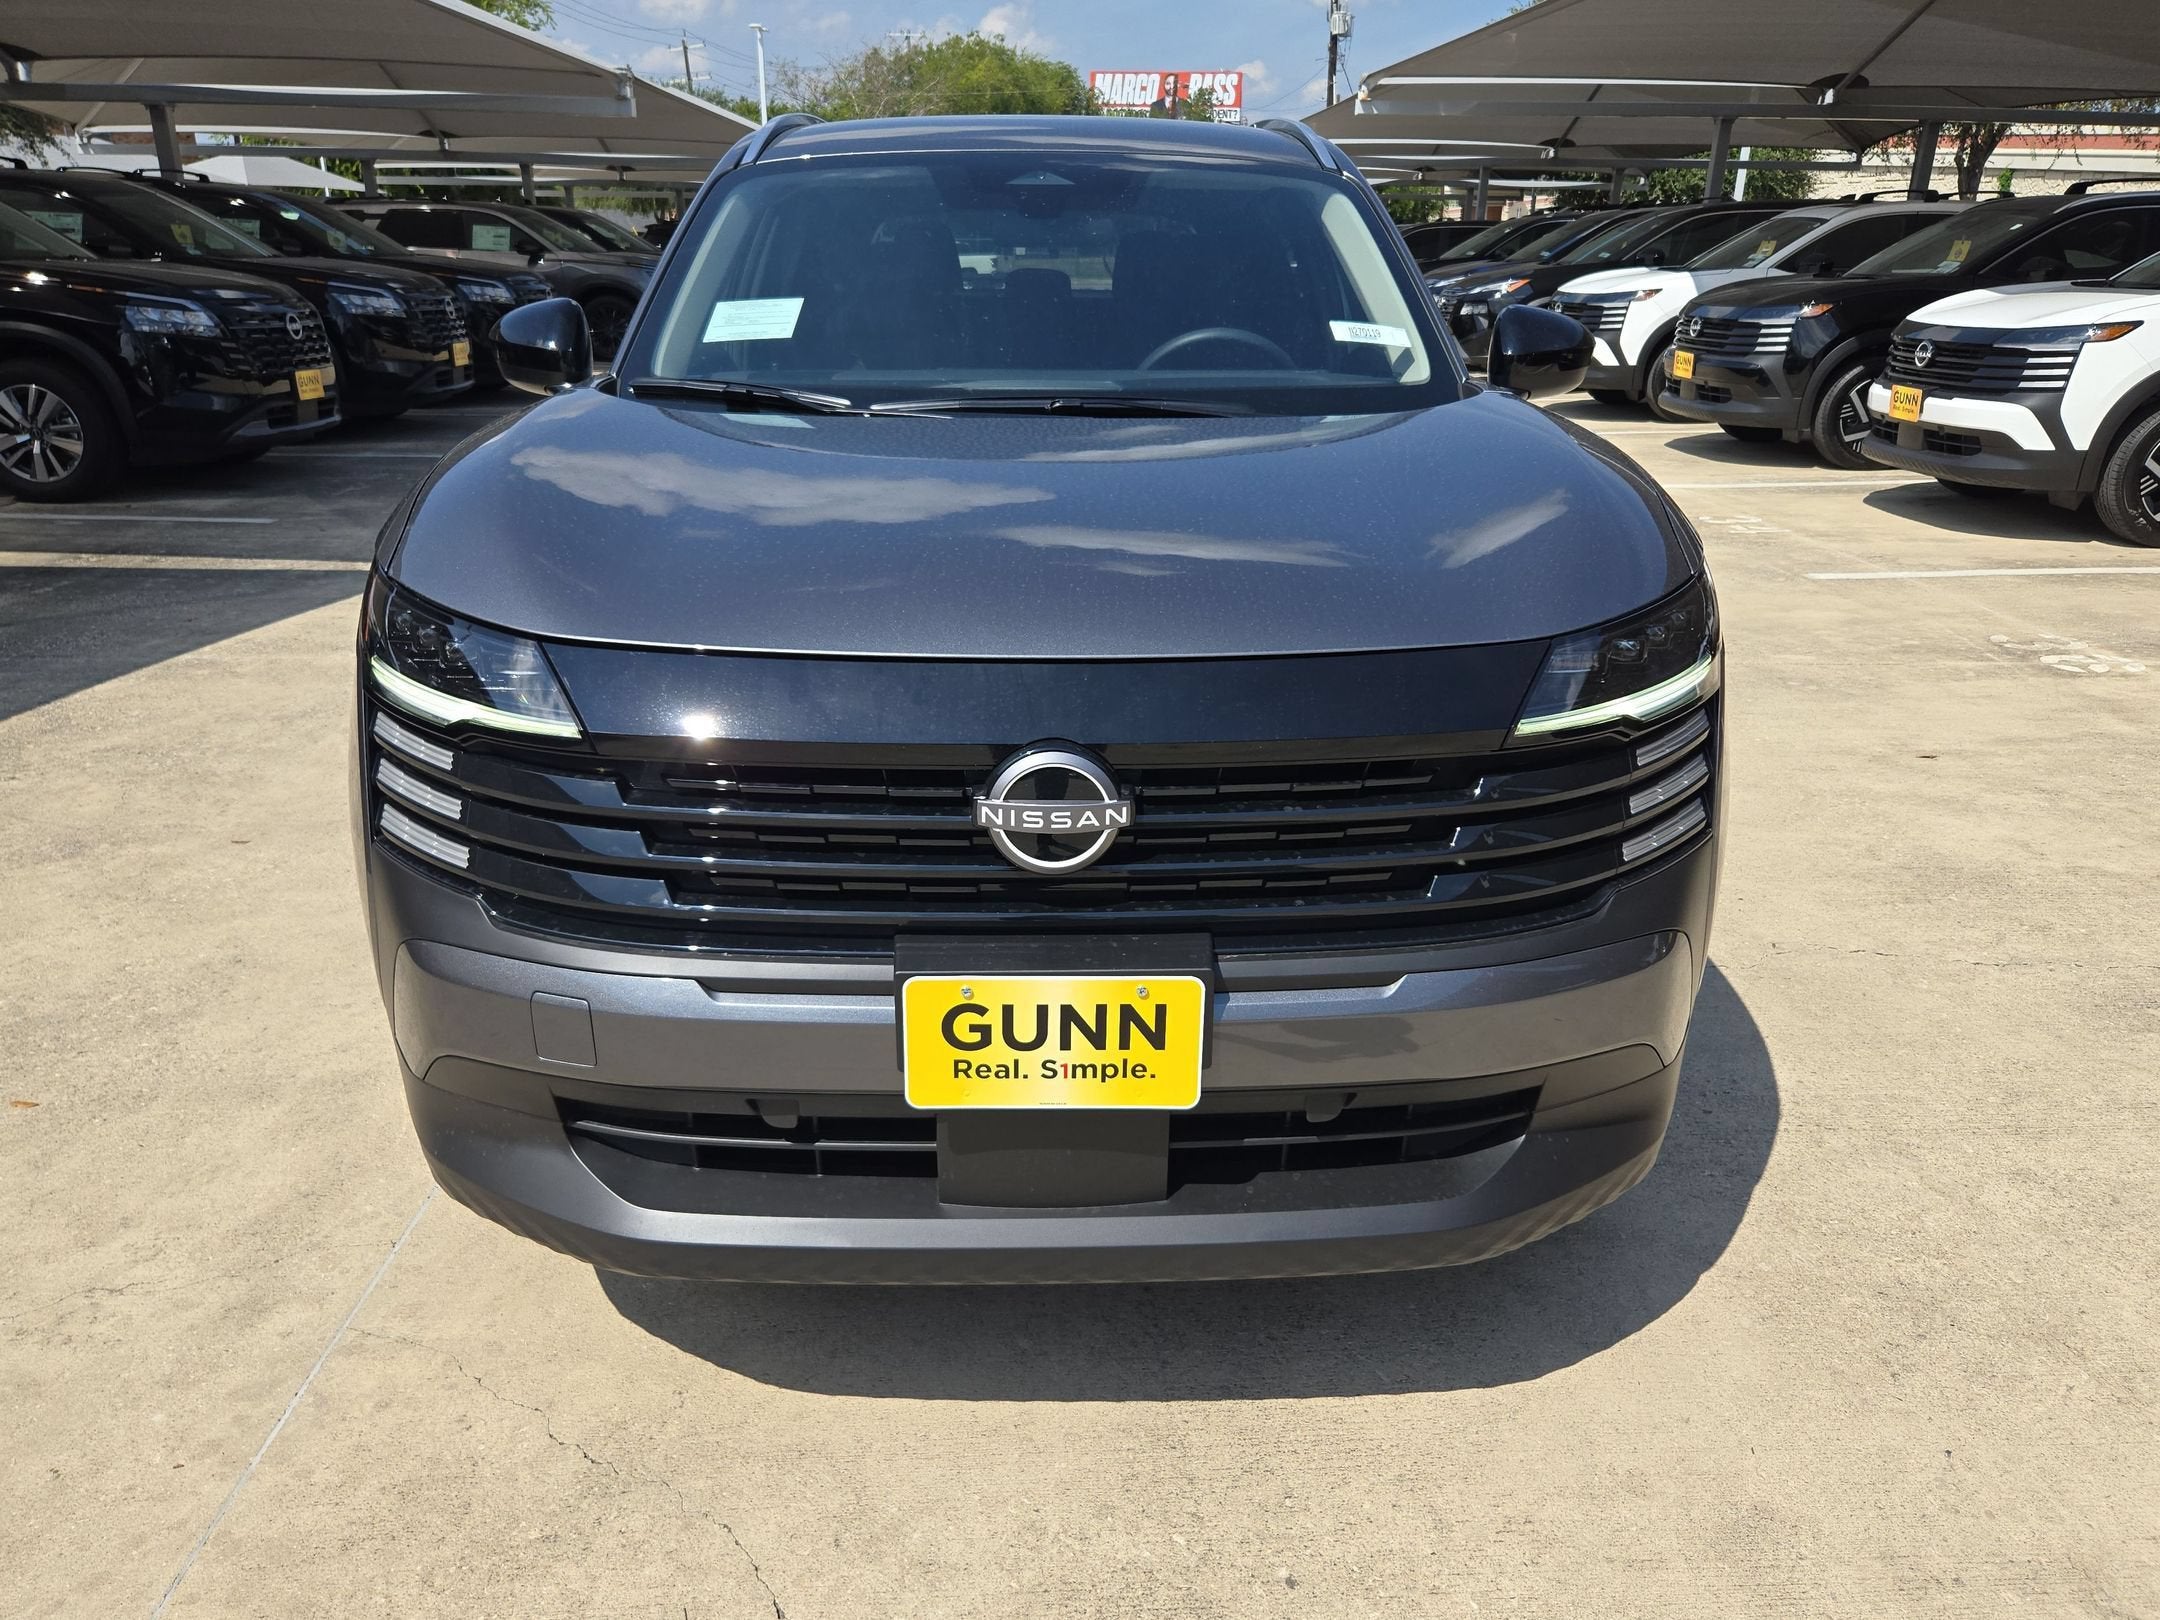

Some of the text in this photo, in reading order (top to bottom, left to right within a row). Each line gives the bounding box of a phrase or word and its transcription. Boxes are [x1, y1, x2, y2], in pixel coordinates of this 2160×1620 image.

[1095, 73, 1160, 105] MARCO
[1893, 390, 1919, 406] GUNN
[981, 806, 1127, 829] NISSAN
[941, 1002, 1168, 1052] GUNN
[953, 1058, 1029, 1080] Real.
